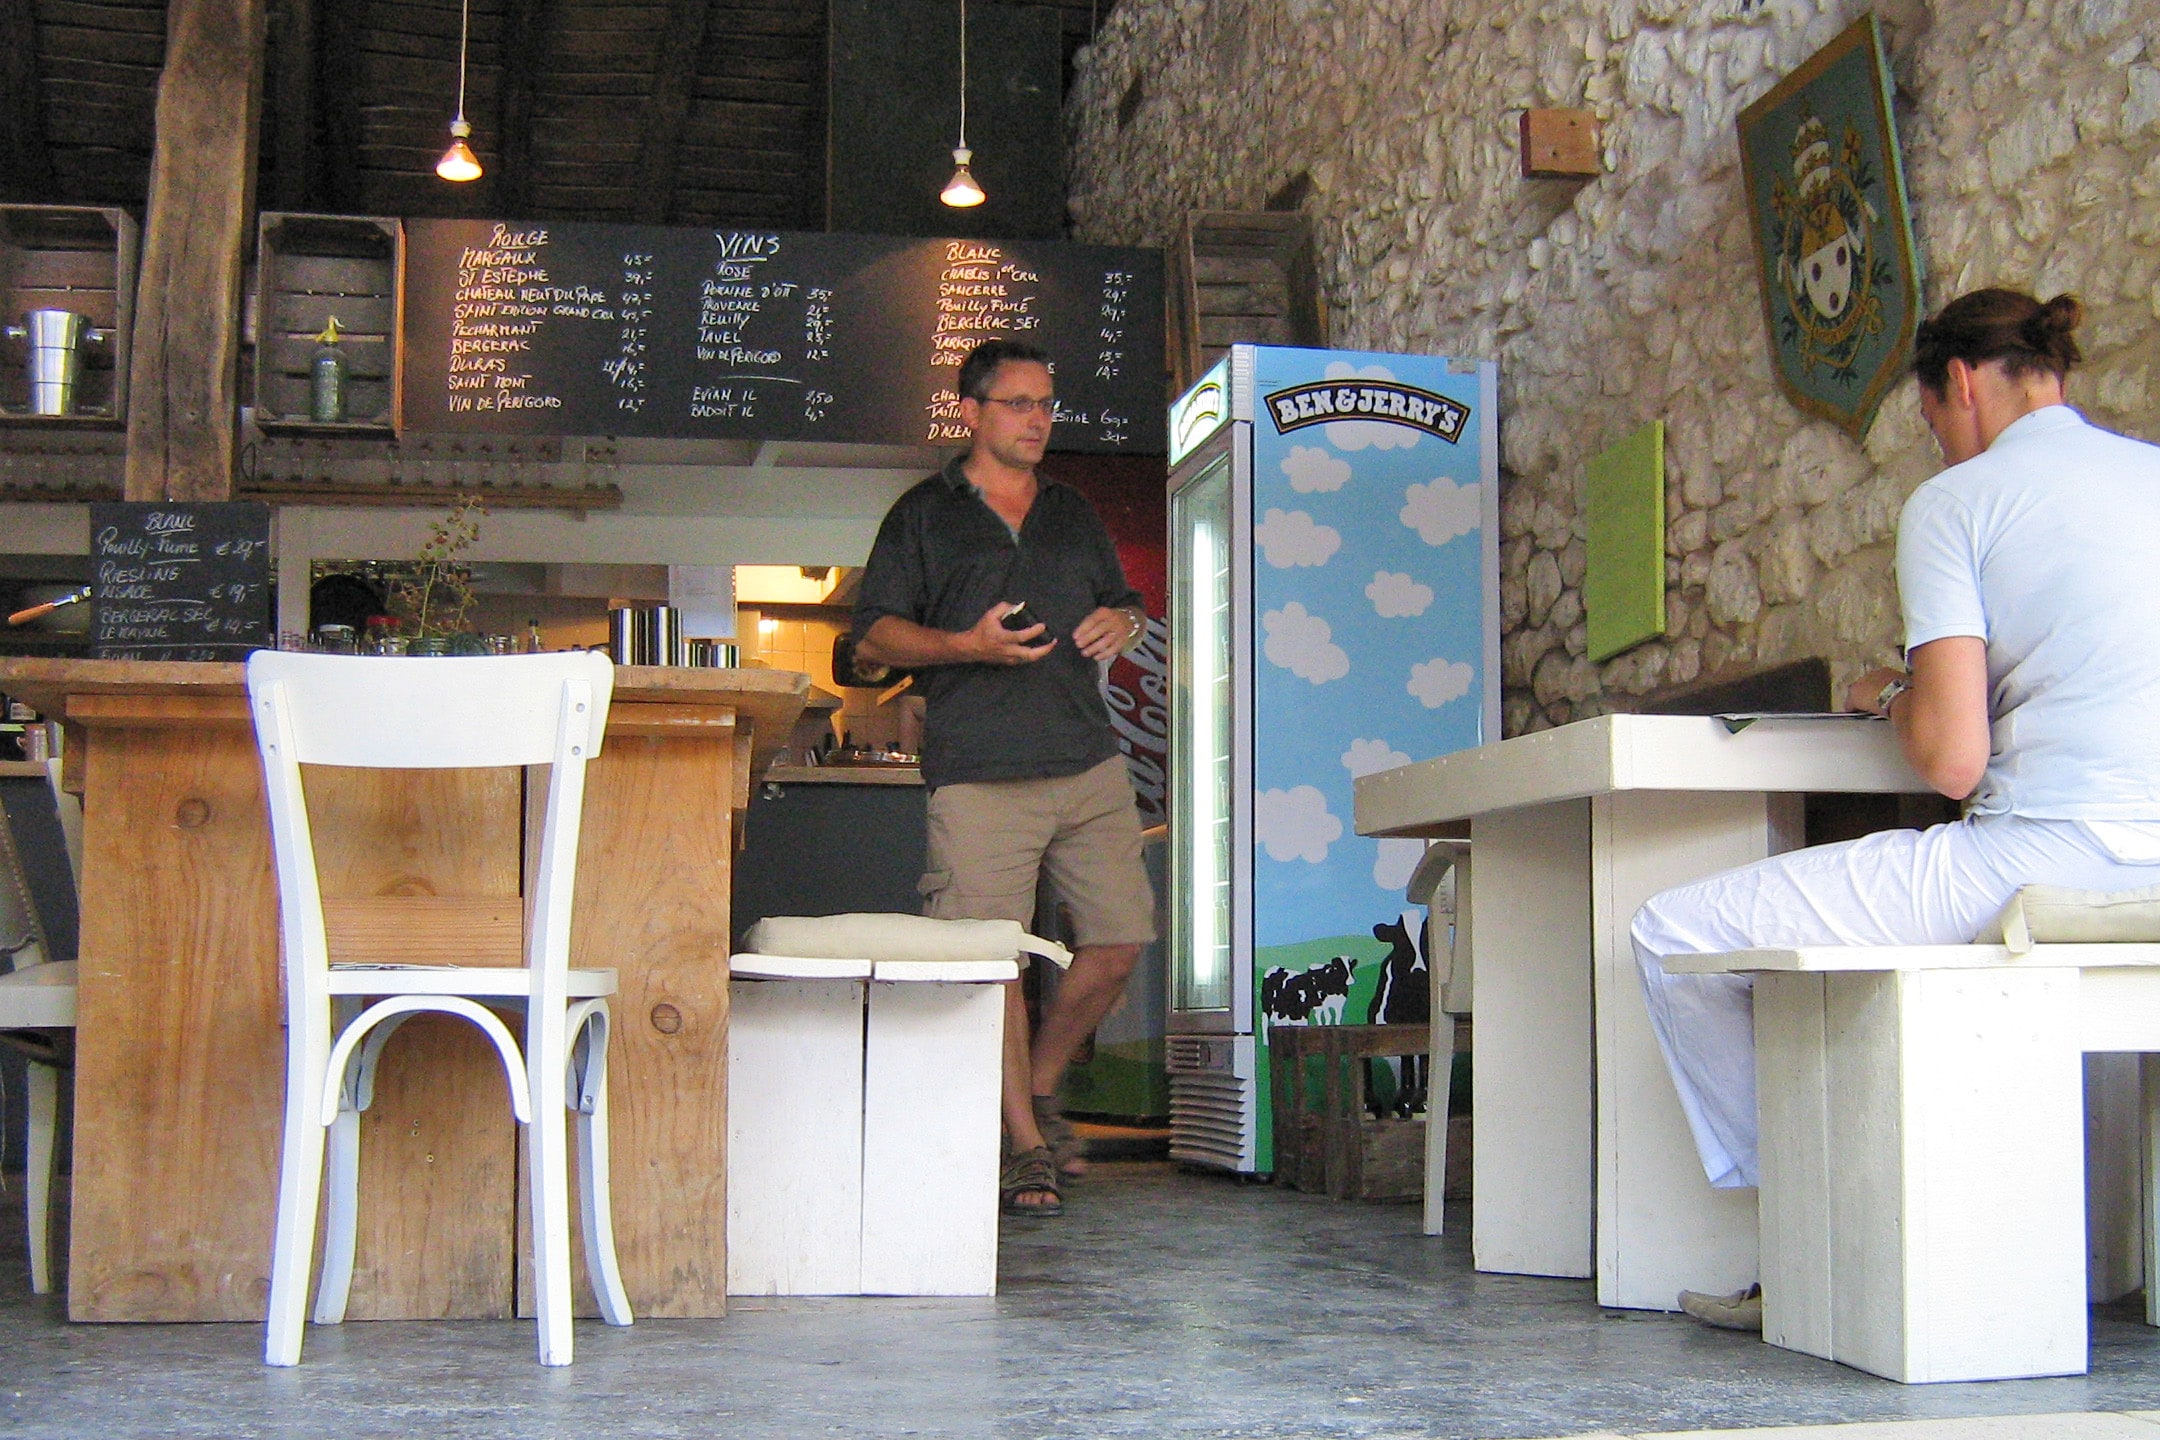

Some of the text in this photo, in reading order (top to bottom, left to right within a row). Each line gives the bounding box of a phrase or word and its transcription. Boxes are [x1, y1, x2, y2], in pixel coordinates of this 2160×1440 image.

[489, 223, 549, 248] ROUGE
[715, 232, 780, 258] VINS
[946, 242, 1002, 261] BLANC
[459, 247, 537, 268] MARGAUX
[941, 267, 990, 281] CHABLIS
[1011, 270, 1039, 282] CRU
[455, 285, 516, 301] CHATEAU
[939, 283, 1008, 296] SANCERRE
[454, 302, 504, 319] SAINT
[553, 305, 589, 318] GRAND
[701, 296, 760, 312] PROVENCE
[453, 320, 544, 337] PECHARMANT
[936, 313, 1010, 332] BERGERAC
[698, 326, 741, 344] TAVEL
[452, 339, 530, 354] BERGERAC
[449, 355, 506, 373] DURAS
[448, 374, 491, 390] SAINT
[692, 386, 732, 401] EVIAN
[449, 395, 472, 412] VIN
[477, 395, 495, 410] DE
[215, 541, 232, 556] €
[100, 560, 181, 584] RIESLING
[100, 584, 155, 599] ALSACE
[99, 606, 180, 624] BERGERAC
